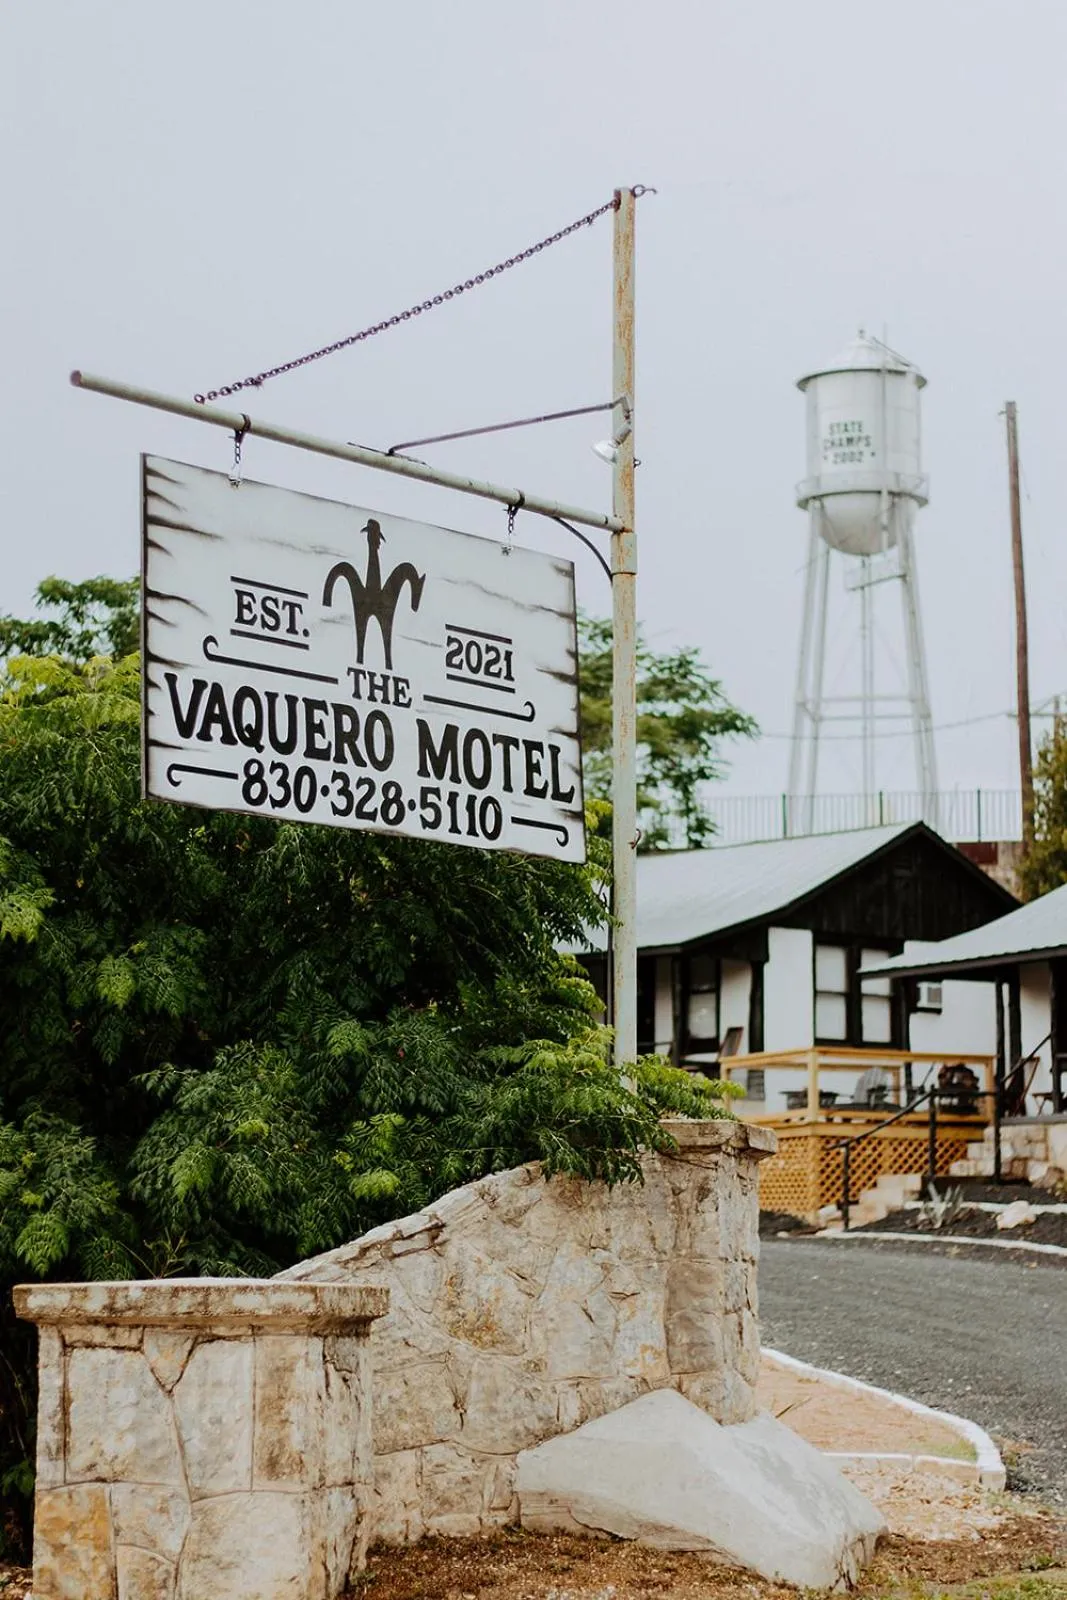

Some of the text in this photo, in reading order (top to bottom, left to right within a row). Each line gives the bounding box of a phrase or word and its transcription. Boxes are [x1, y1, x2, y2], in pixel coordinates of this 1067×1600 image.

[824, 435, 872, 451] CHAMPS
[829, 420, 863, 436] STATE
[234, 589, 310, 637] EST.
[446, 635, 515, 682] 2021
[346, 667, 413, 708] THE
[163, 672, 576, 804] VAQUERO MOTEL
